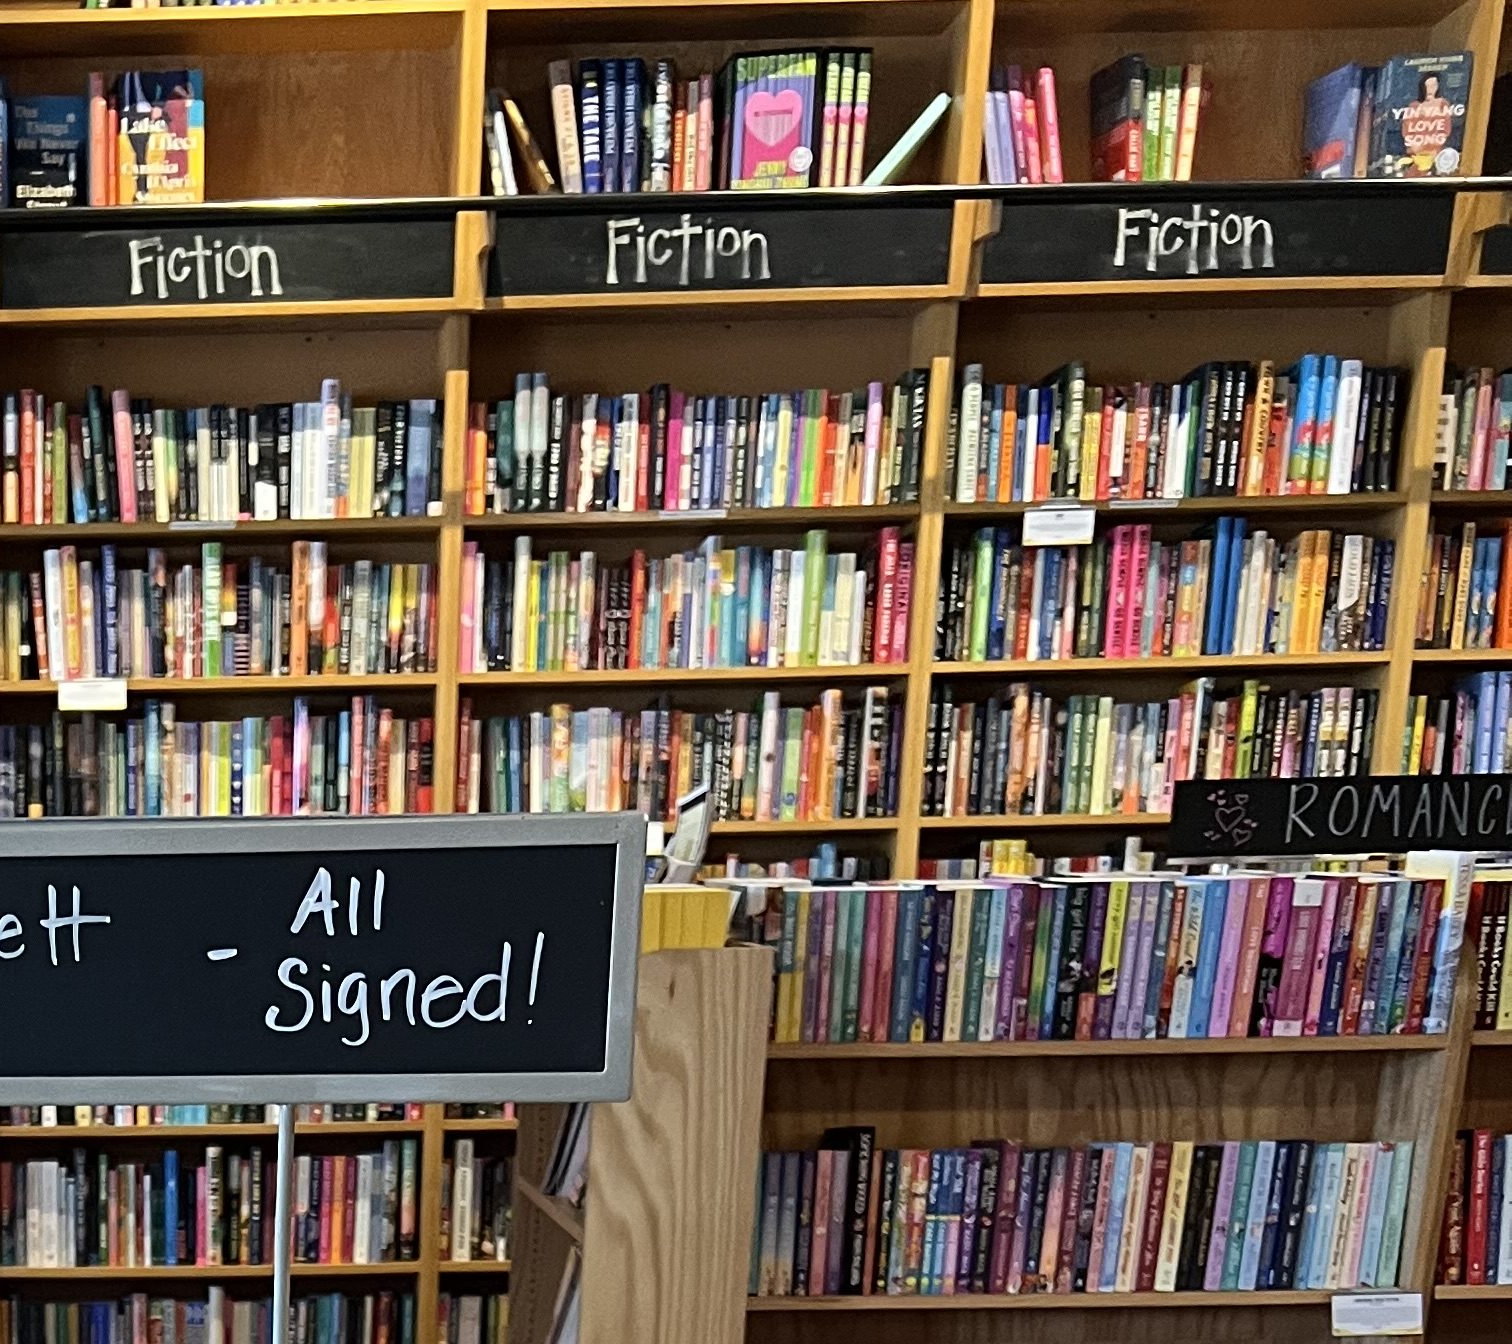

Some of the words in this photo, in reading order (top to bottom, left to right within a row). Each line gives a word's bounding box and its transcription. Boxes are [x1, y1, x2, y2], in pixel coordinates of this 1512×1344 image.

[1392, 104, 1420, 119] YIN
[1420, 103, 1465, 118] YANG
[1404, 134, 1446, 147] SONG
[1409, 119, 1445, 131] LOVE
[128, 236, 282, 300] Fiction
[605, 212, 772, 285] Fiction
[1114, 205, 1274, 275] Fiction
[289, 868, 386, 937] All
[264, 932, 546, 1047] Signed!
